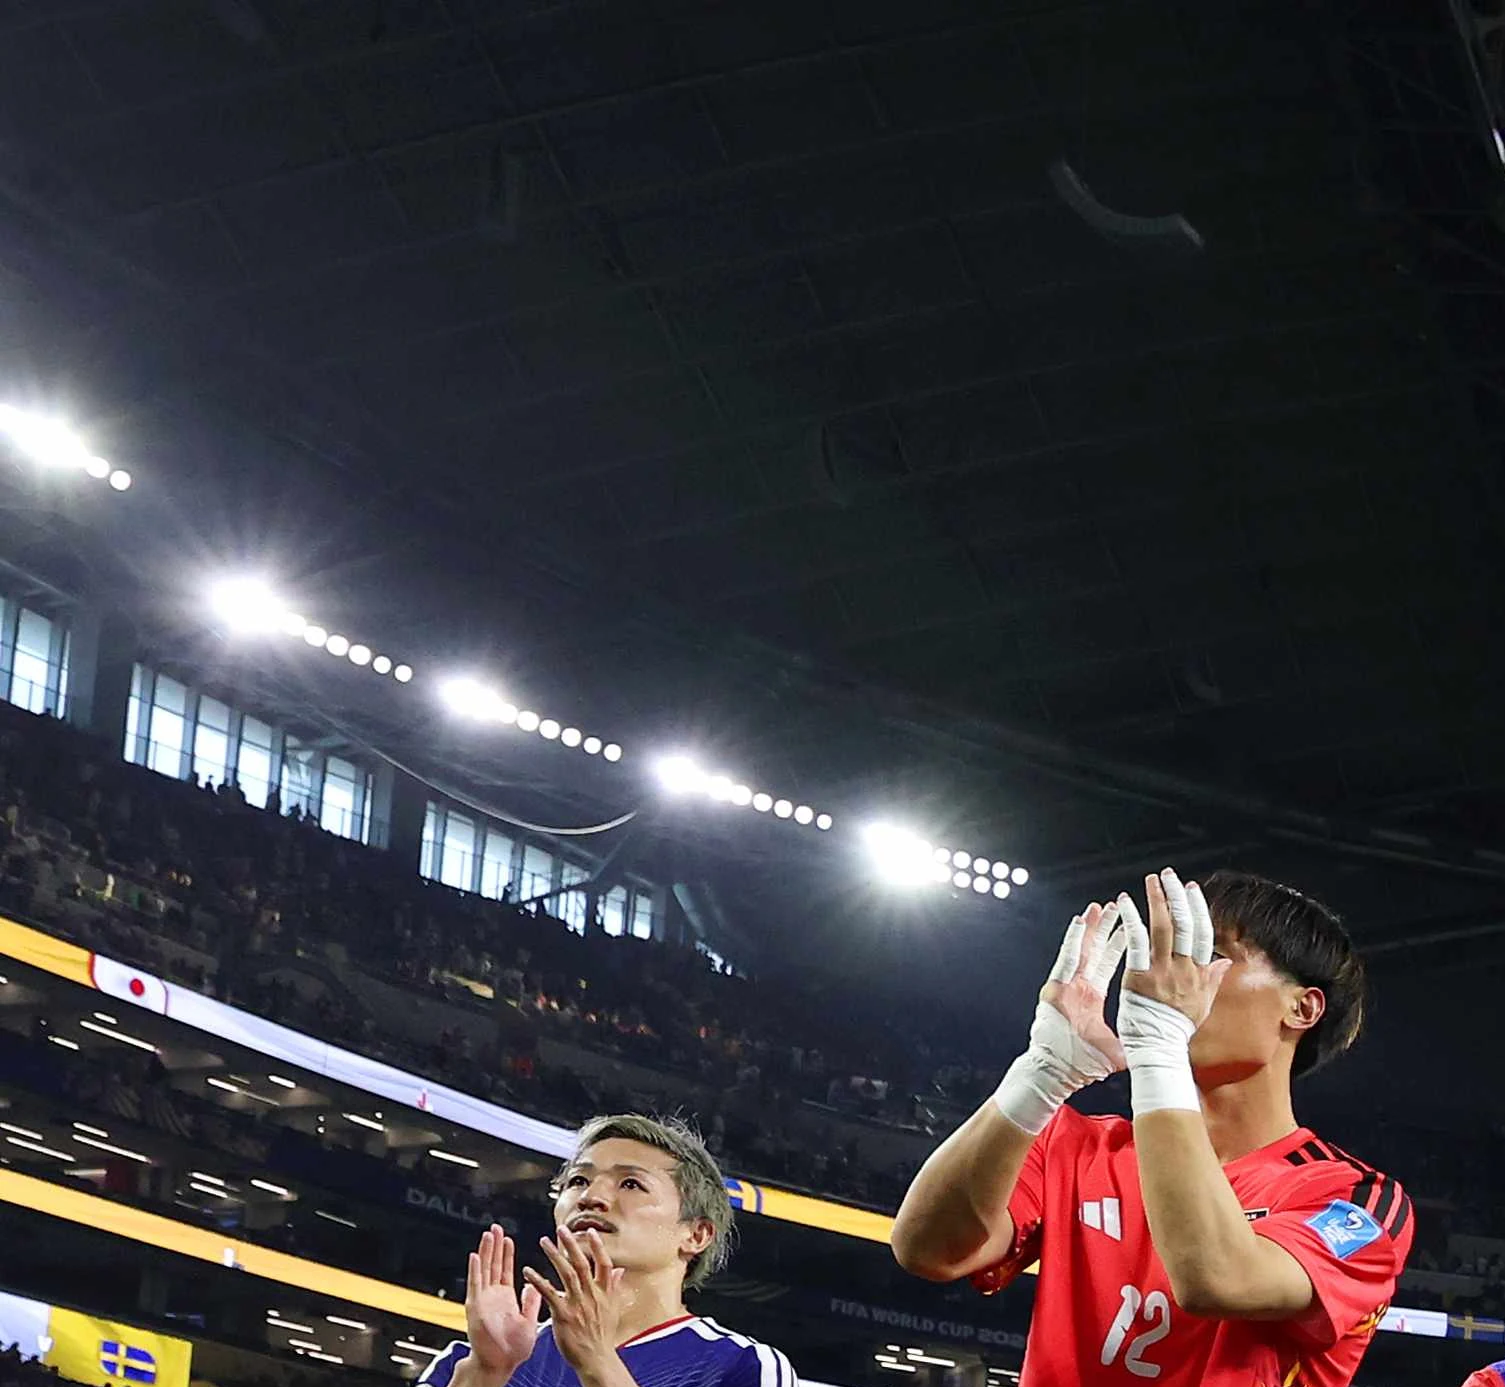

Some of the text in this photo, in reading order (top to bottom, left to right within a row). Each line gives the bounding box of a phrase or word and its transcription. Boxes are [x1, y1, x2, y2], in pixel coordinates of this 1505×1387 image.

[831, 1298, 1027, 1349] FIFA WORLD CUP 202
[1100, 1285, 1170, 1378] 12
